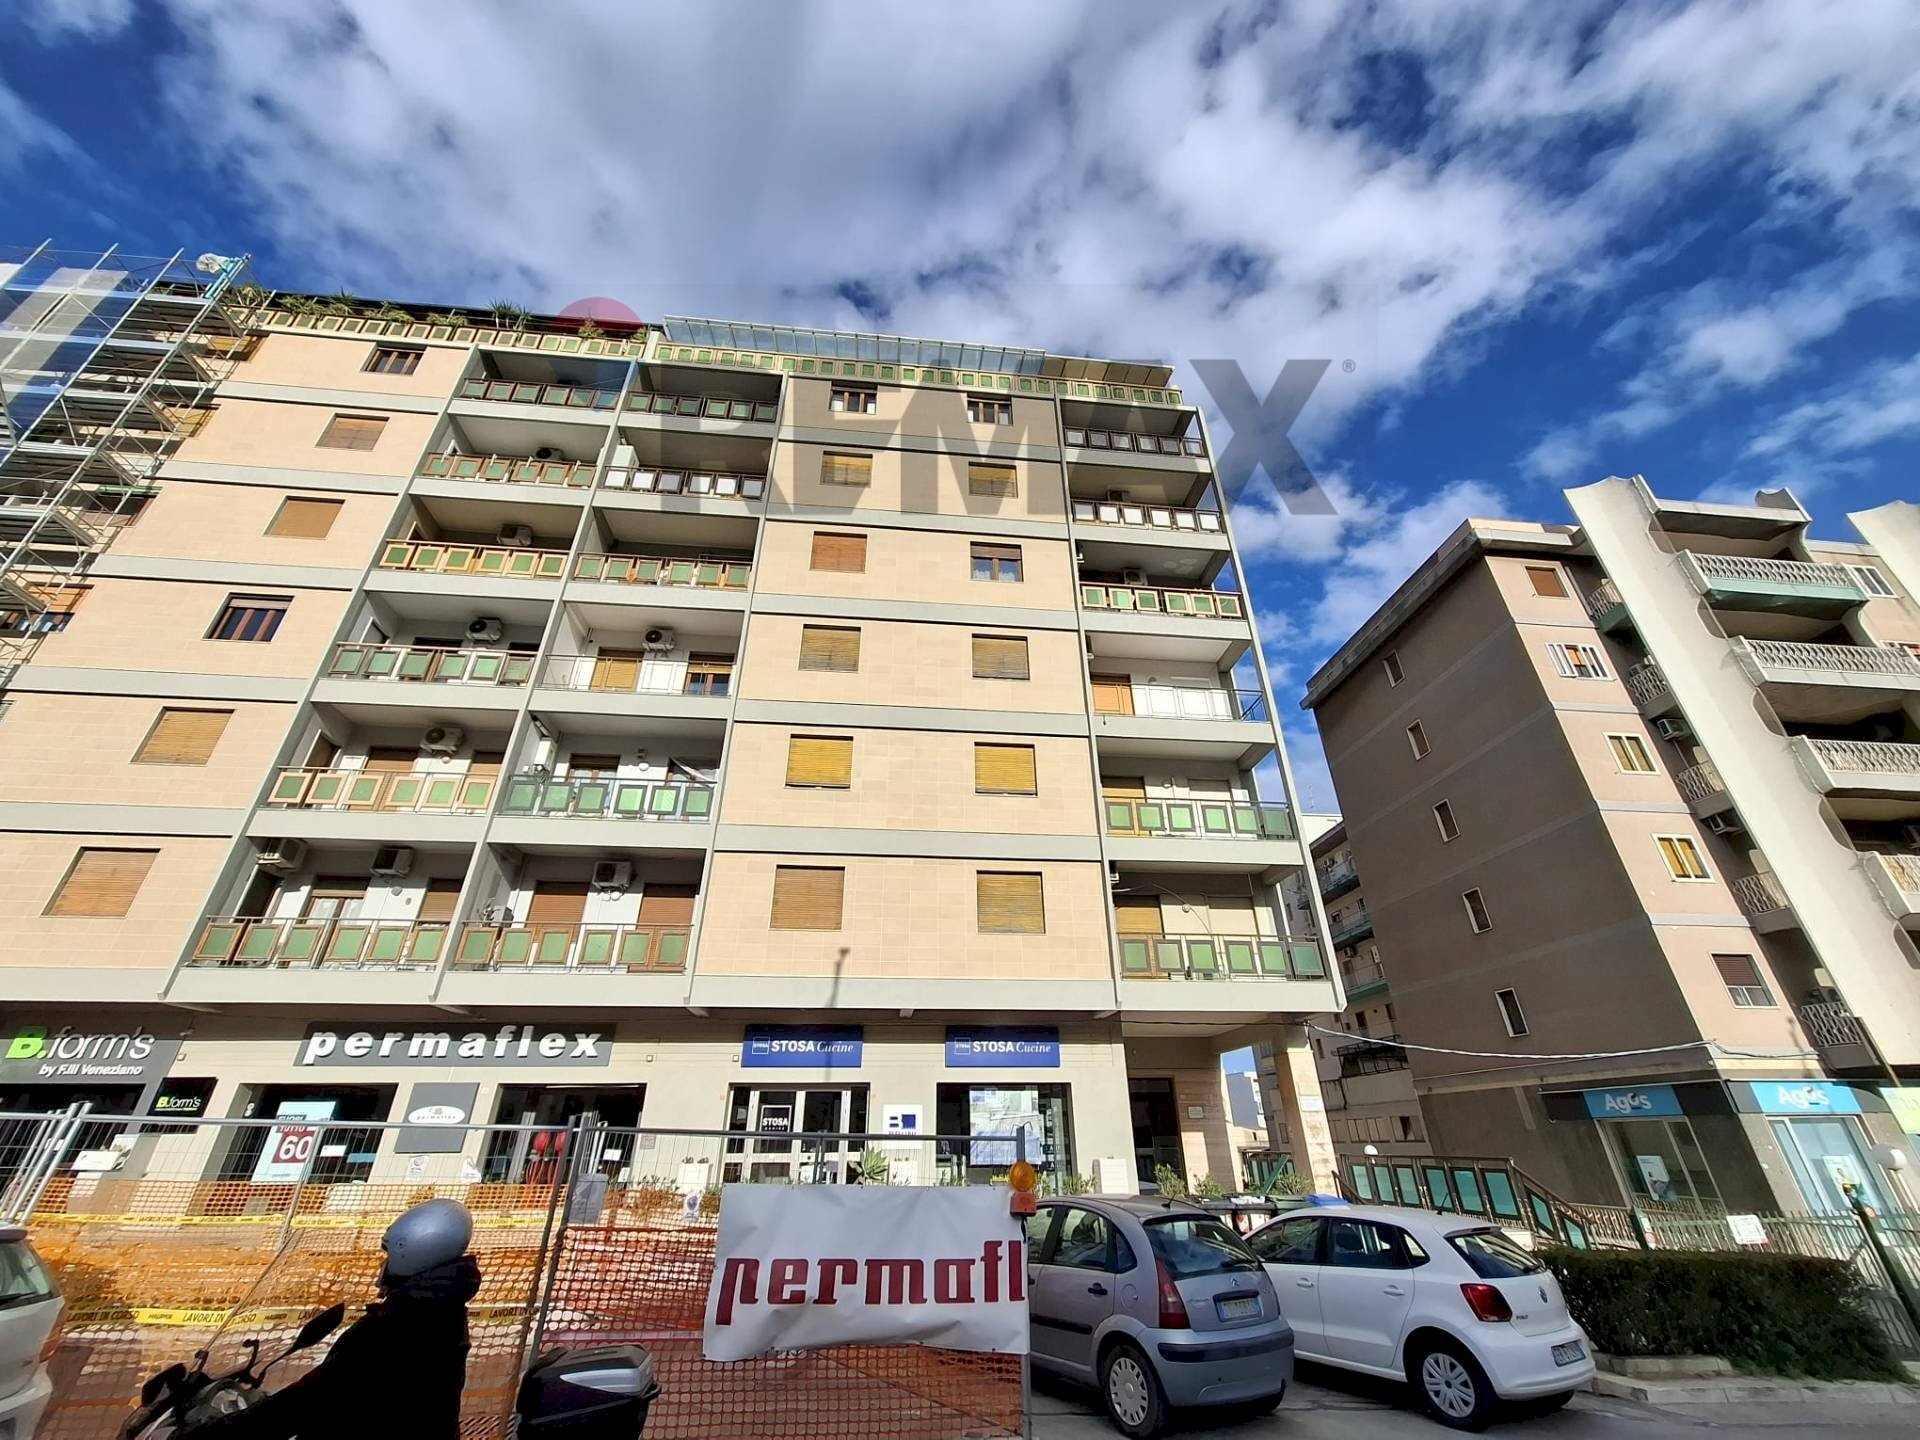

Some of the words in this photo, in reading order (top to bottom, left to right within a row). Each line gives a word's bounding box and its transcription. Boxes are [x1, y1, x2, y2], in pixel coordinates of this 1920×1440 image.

[303, 1025, 603, 1065] permaflex
[771, 1040, 815, 1052] STOSA
[817, 1040, 854, 1053] Cucine
[972, 1040, 1014, 1053] STOSA
[1015, 1040, 1051, 1053] Cucine
[39, 1063, 57, 1078] by
[81, 1063, 143, 1076] Veneziano
[1604, 1091, 1651, 1114] Agos
[1777, 1084, 1830, 1108] Agos
[762, 1117, 788, 1126] STOSA
[279, 1135, 312, 1161] 60
[715, 1240, 1026, 1326] permafl
[182, 1311, 213, 1323] LAVORI
[214, 1312, 227, 1323] IN
